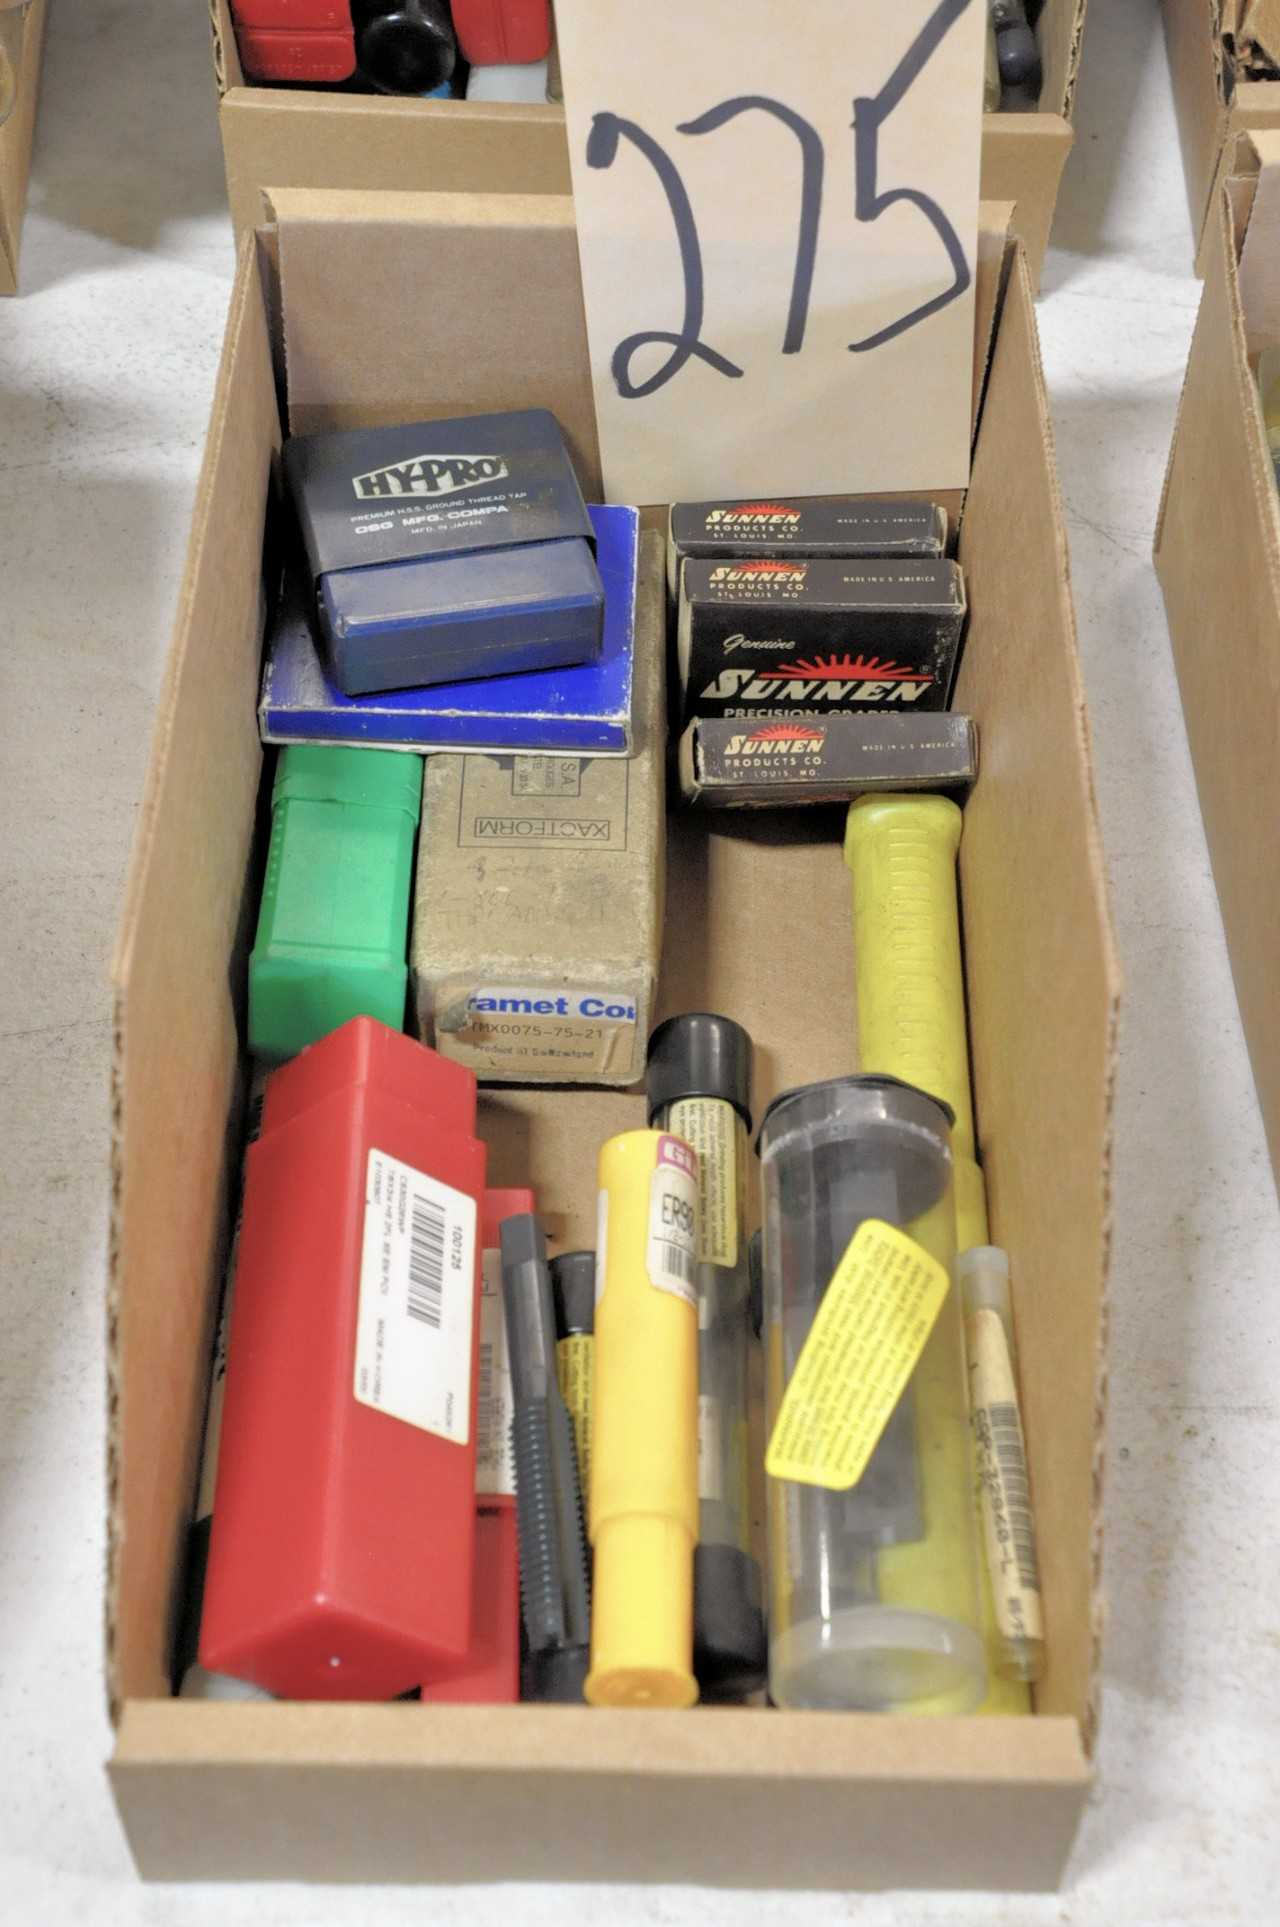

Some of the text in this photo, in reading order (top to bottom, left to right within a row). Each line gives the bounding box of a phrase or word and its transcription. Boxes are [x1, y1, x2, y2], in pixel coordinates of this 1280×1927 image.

[586, 0, 974, 400] 275
[350, 509, 395, 522] PREMIUM
[426, 499, 465, 511] GROUND
[468, 494, 506, 505] THREAD
[509, 491, 527, 499] TAP
[450, 519, 482, 530] JAPAN
[705, 510, 800, 523] SUNNEN
[354, 521, 394, 534] OSG
[706, 524, 775, 532] PRODUCTS
[709, 567, 808, 582] SUNNEN
[723, 633, 796, 655] Genuine
[700, 669, 933, 701] SUNNEN
[724, 735, 825, 755] SUNNEN
[724, 757, 797, 767] PRODUCTS
[479, 820, 608, 838] XACTFORM
